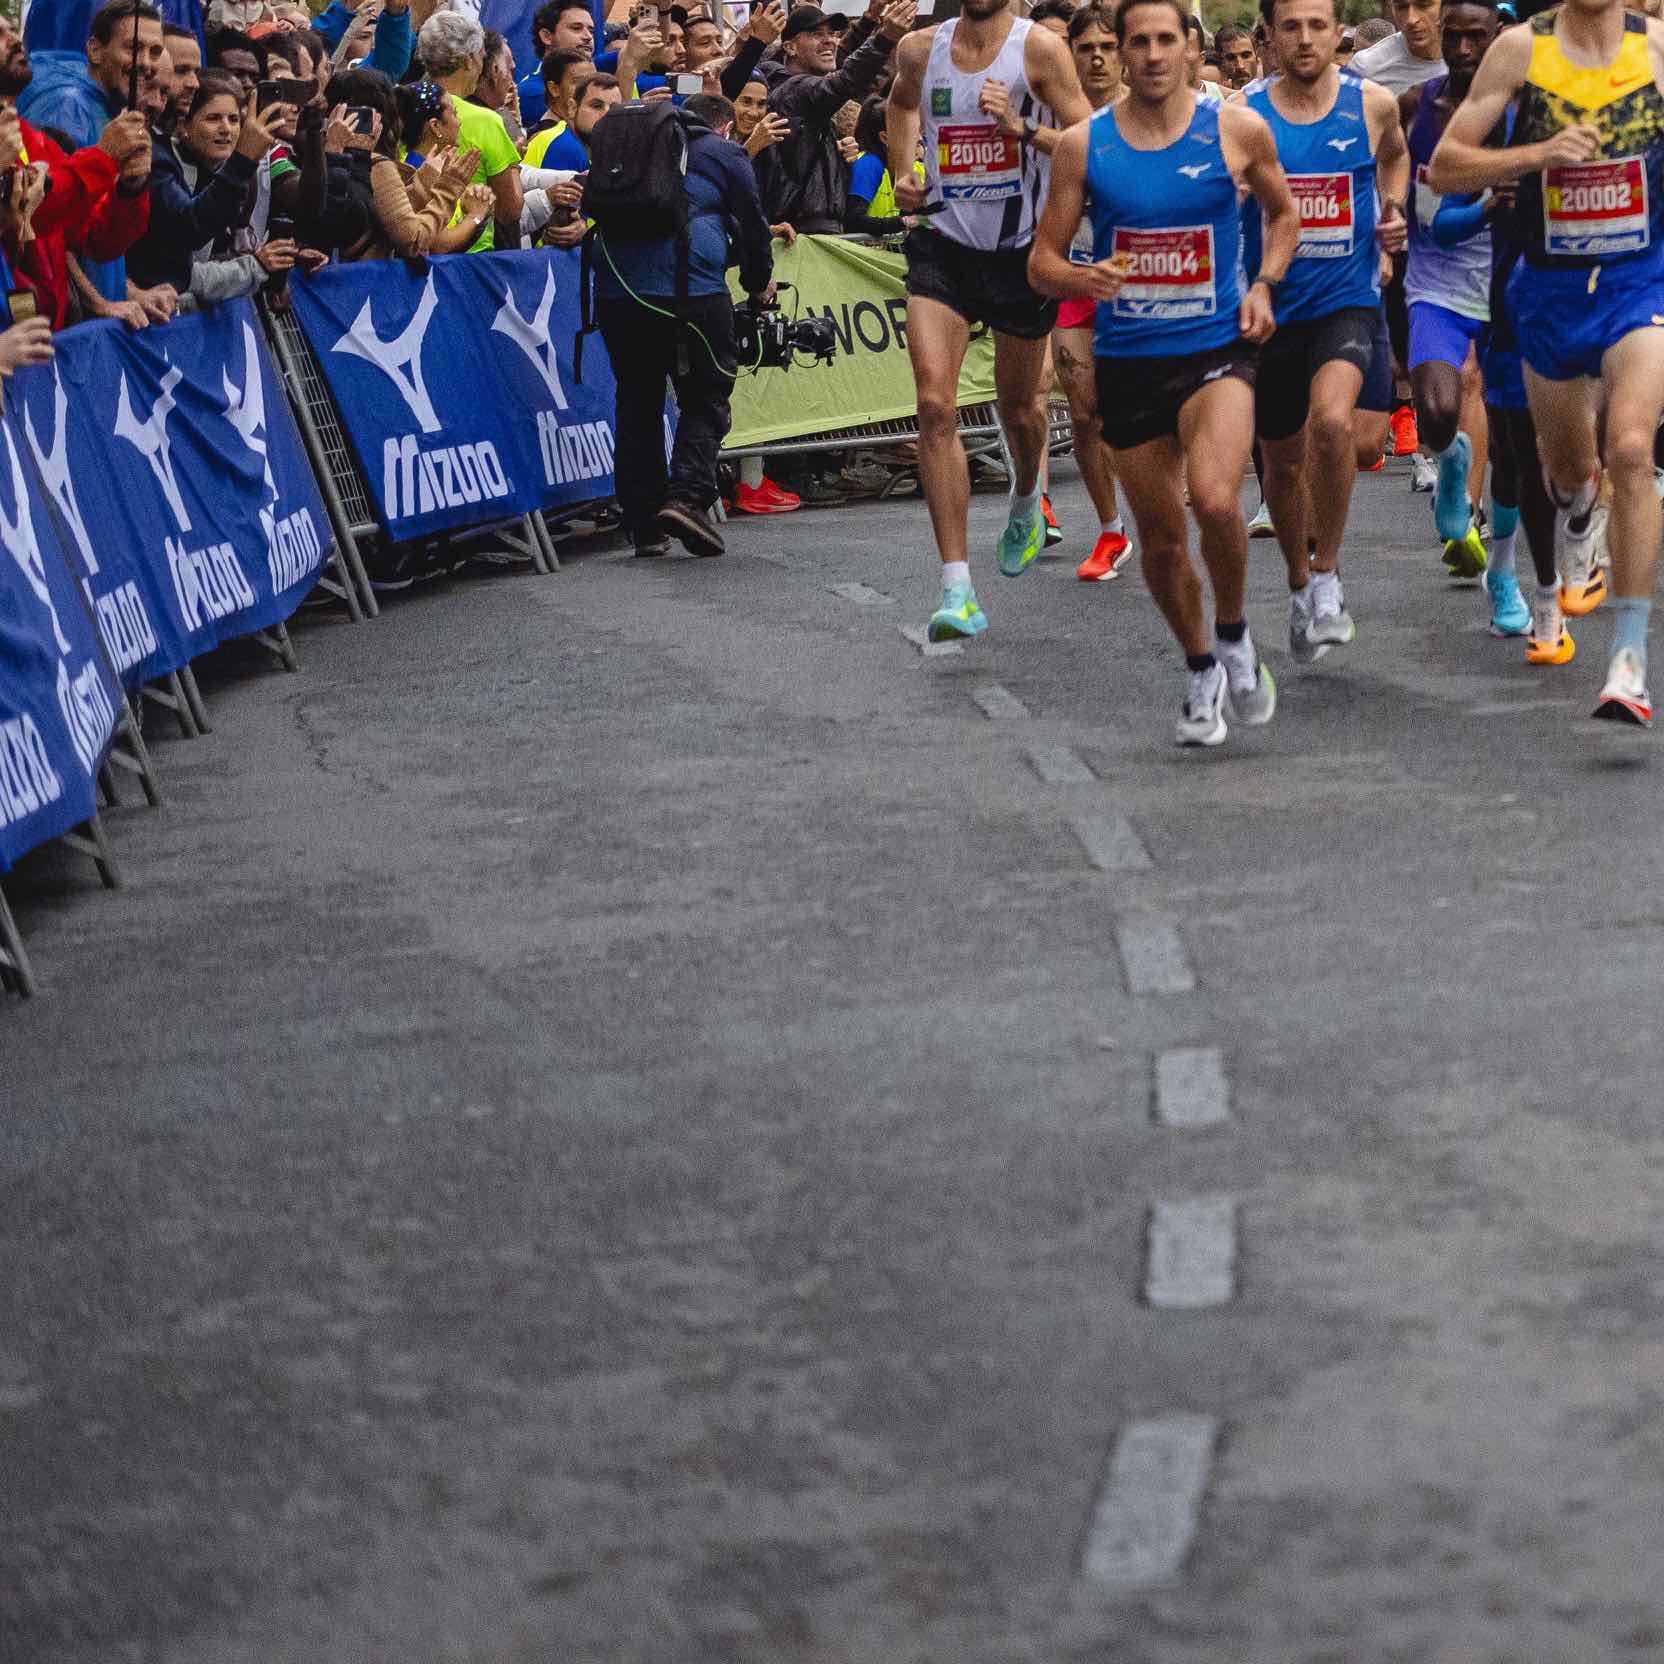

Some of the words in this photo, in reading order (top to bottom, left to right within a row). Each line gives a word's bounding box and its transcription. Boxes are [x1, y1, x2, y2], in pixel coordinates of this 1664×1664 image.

[951, 142, 1005, 166] 20102
[1560, 183, 1632, 212] 20002
[1128, 250, 1199, 276] 20004
[384, 434, 509, 520] MIZUNO
